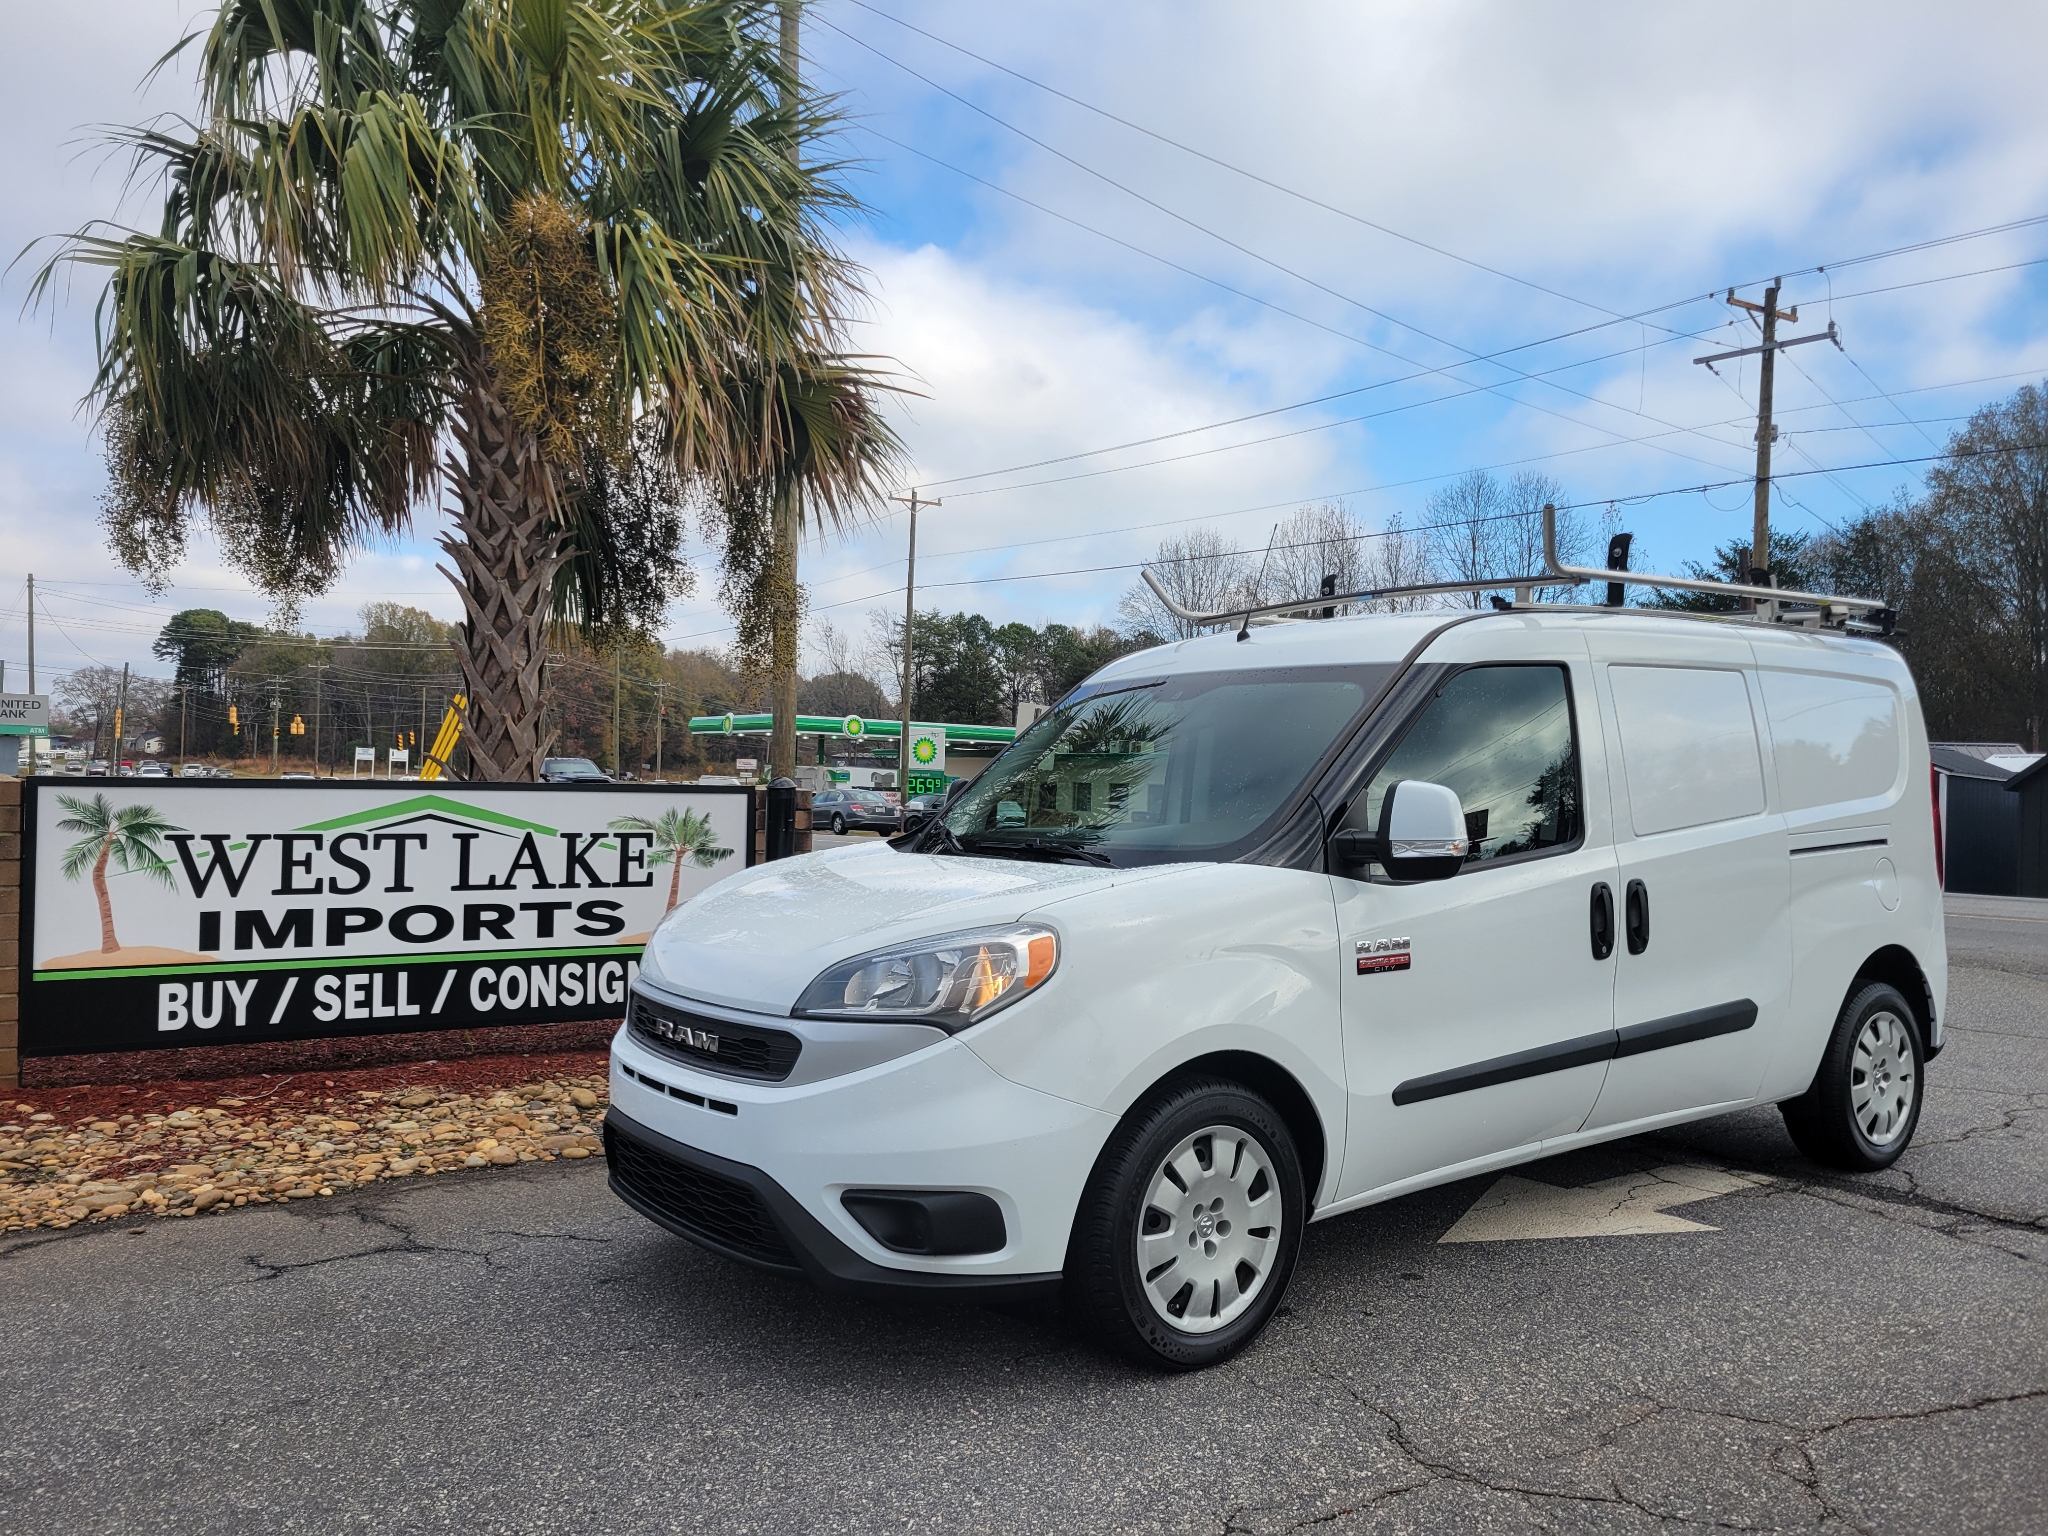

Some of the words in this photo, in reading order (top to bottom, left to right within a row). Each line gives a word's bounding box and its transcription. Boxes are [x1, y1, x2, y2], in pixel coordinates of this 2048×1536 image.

[0, 710, 26, 718] ANK
[1, 700, 41, 710] NITED
[163, 832, 427, 899] WEST
[450, 831, 654, 892] LAKE
[198, 899, 626, 952] IMPORTS
[1355, 936, 1410, 954] RAM
[157, 978, 259, 1032] BUY
[268, 976, 300, 1025] /
[312, 970, 421, 1022] SELL
[430, 968, 458, 1014] /
[655, 1018, 720, 1054] RAM
